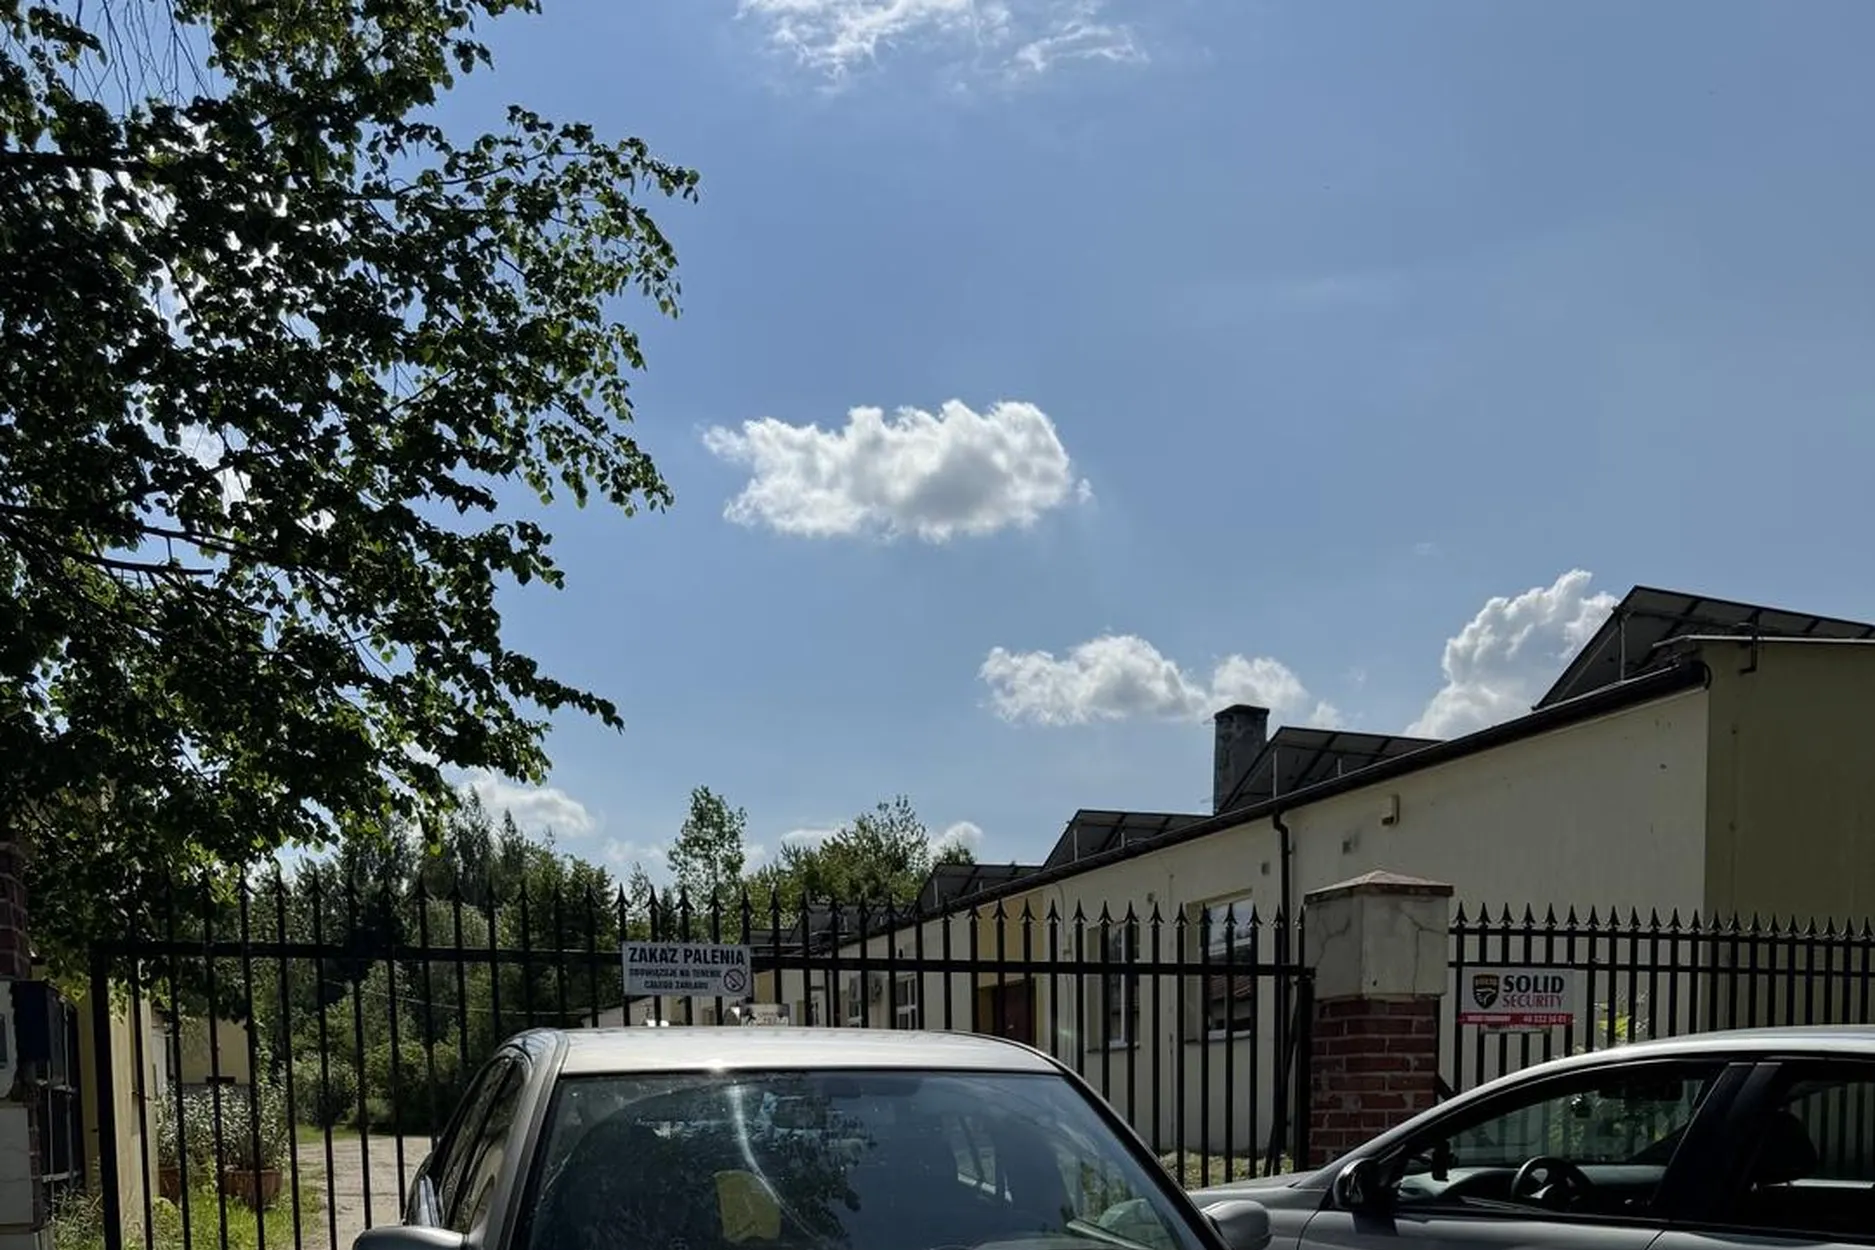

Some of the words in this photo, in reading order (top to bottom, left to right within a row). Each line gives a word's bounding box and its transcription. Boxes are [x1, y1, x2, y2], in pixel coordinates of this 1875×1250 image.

[628, 947, 679, 964] ZAKAZ
[683, 948, 746, 966] PALENIA
[1503, 974, 1565, 993] SOLID
[1502, 994, 1563, 1008] SECURITY
